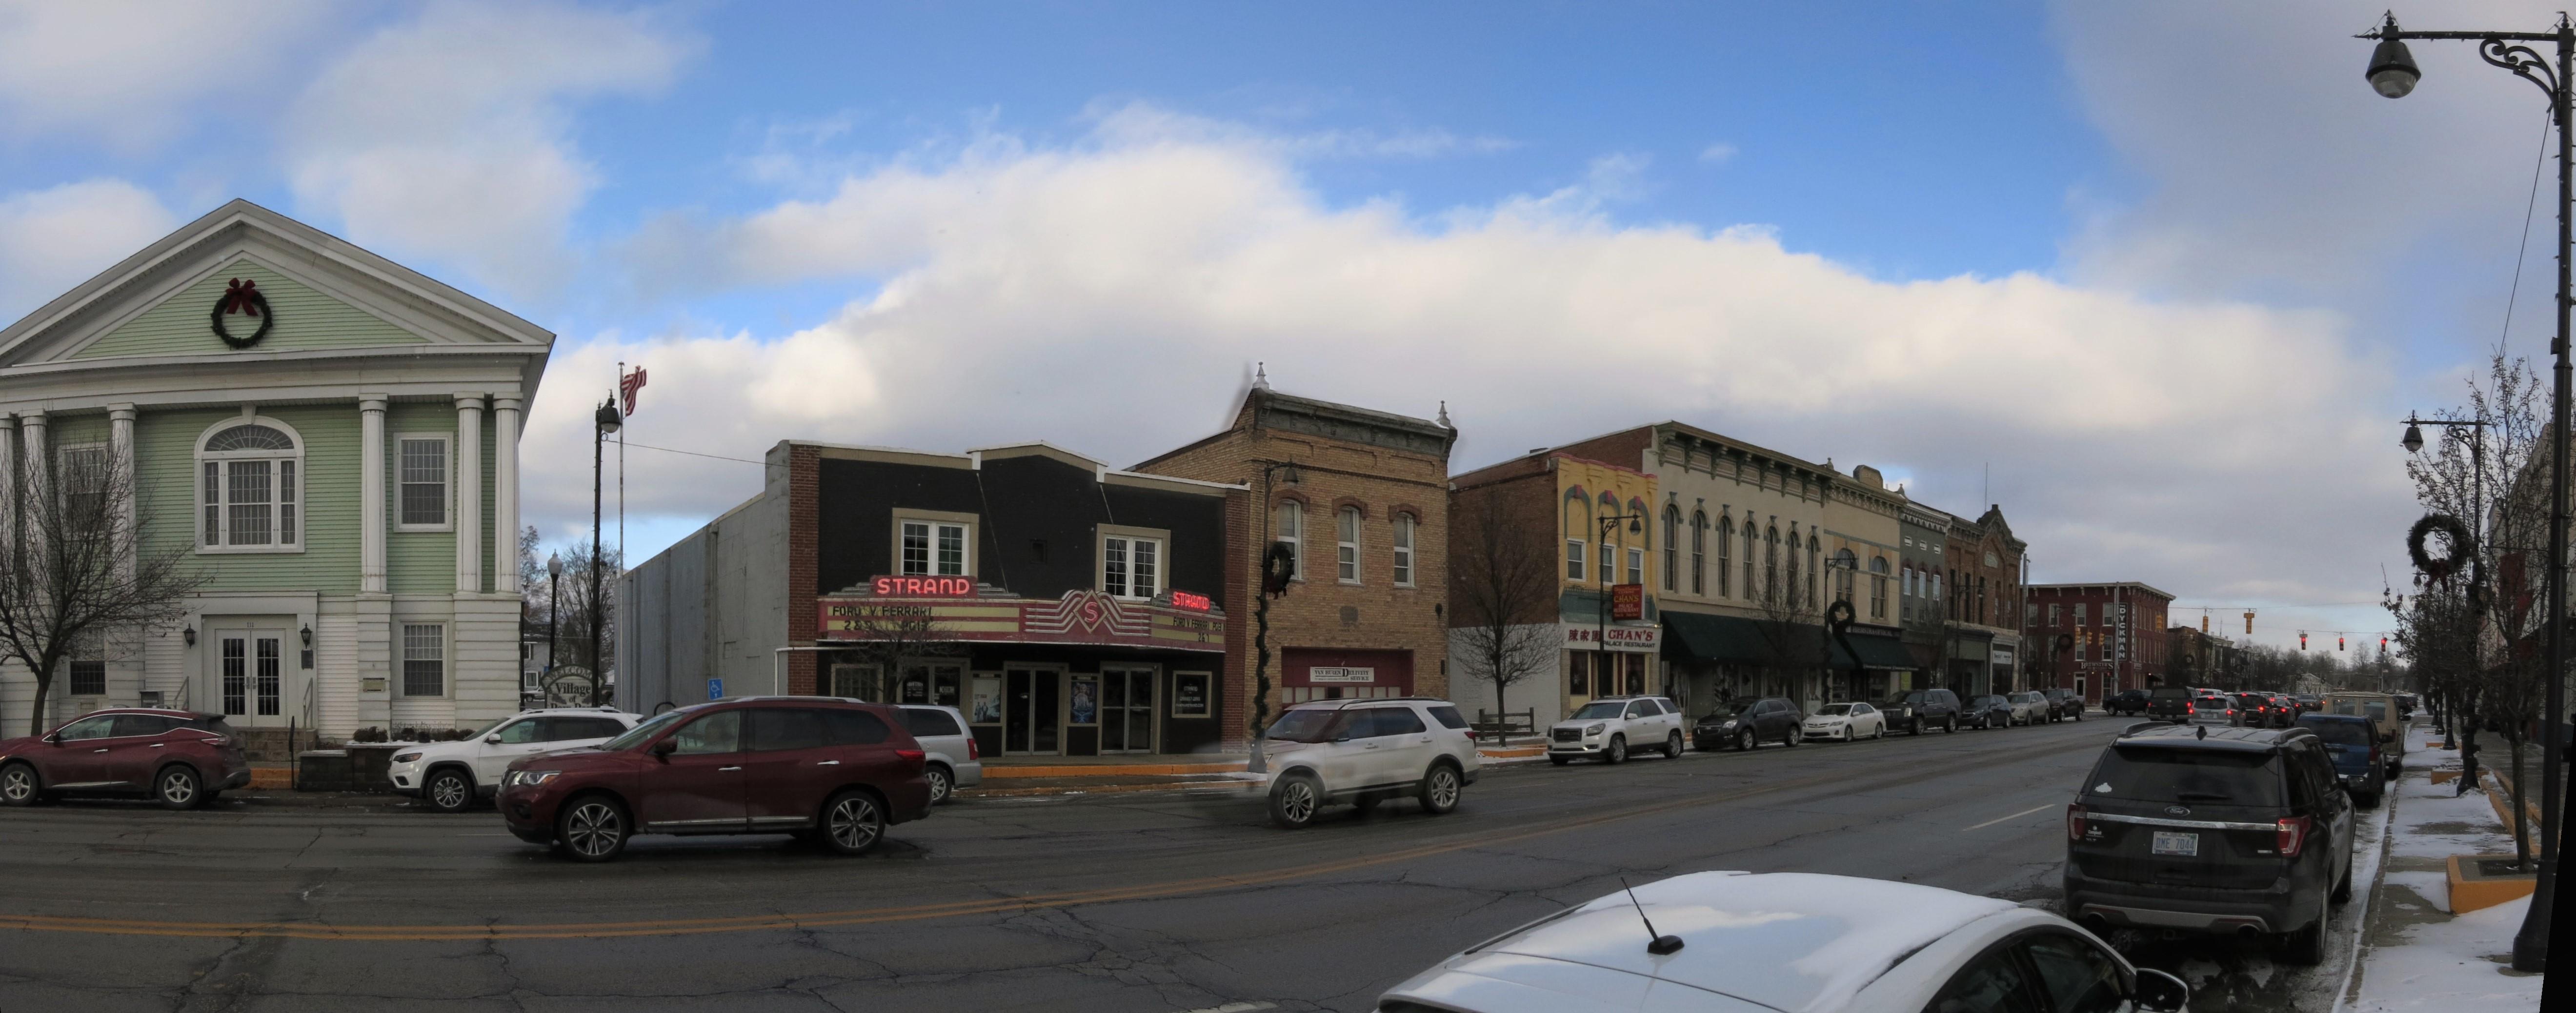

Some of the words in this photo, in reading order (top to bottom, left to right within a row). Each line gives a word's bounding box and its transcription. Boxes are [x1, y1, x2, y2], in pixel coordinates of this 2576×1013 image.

[877, 578, 970, 595] STRAND
[1173, 592, 1209, 609] STRAND
[832, 606, 861, 617] FORD
[882, 606, 932, 617] FERRARI
[1085, 602, 1098, 623] S
[1173, 616, 1185, 627] FORD
[1192, 618, 1209, 629] FERRARI
[1608, 629, 1653, 641] CHAN'S
[547, 666, 592, 680] WELCOM
[555, 683, 591, 697] Village
[2156, 837, 2171, 849] DME
[2175, 838, 2195, 851] 7044
